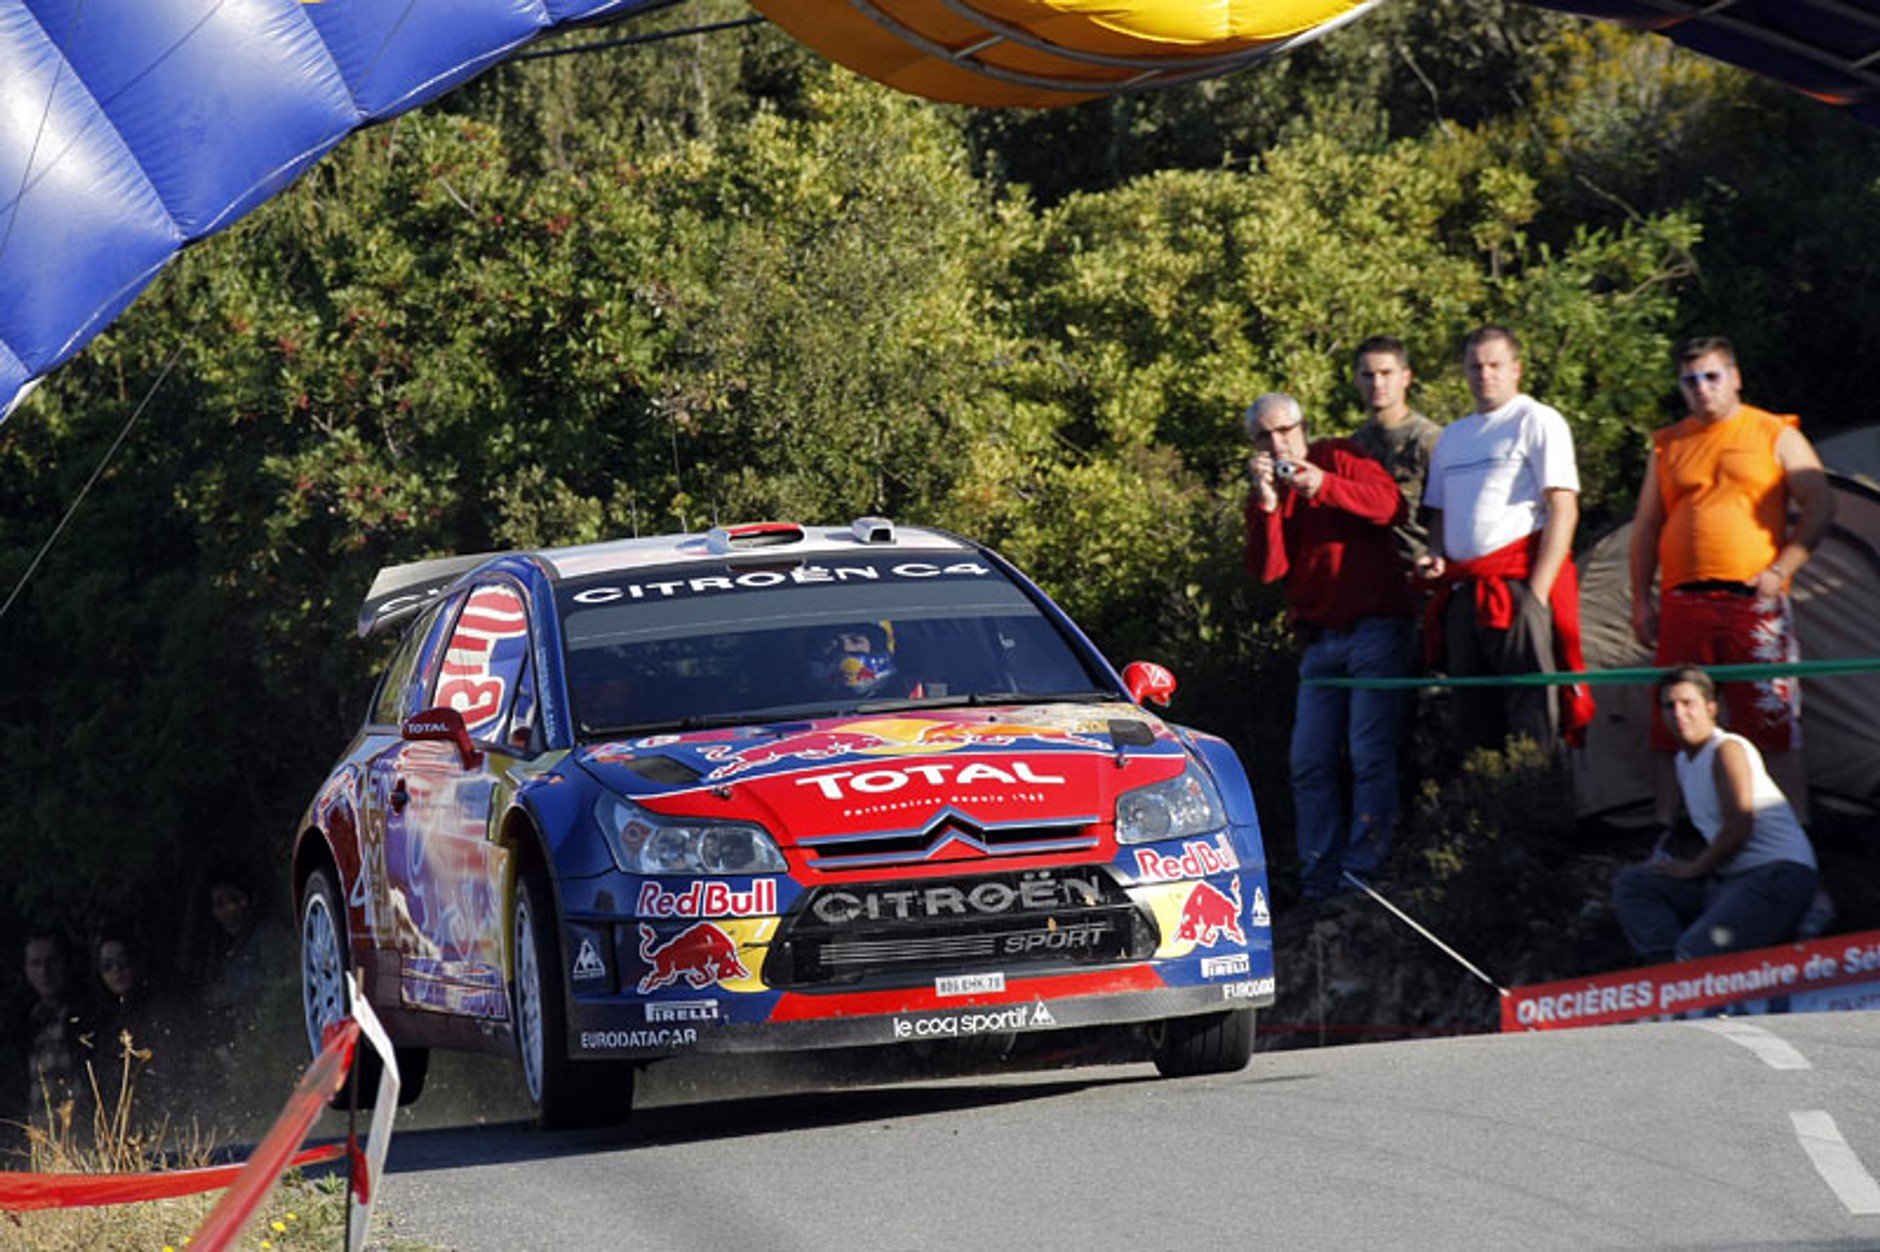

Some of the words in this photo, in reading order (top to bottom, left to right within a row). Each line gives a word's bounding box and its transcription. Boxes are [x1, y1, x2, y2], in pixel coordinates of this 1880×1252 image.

[573, 564, 878, 603] CITROËN
[893, 562, 989, 578] C4
[407, 722, 450, 734] TOTAL
[795, 762, 1066, 800] TOTAL
[1135, 845, 1205, 880] Red
[636, 882, 702, 916] Red
[702, 879, 777, 915] Bull
[813, 872, 1101, 923] CITROËN
[1004, 927, 1102, 953] SPORT
[1516, 979, 1654, 1025] ORCIÈRES
[1660, 962, 1798, 1008] partenaire
[1804, 954, 1838, 979] de
[645, 999, 719, 1022] PIRELLI
[893, 1017, 911, 1037] le
[915, 1011, 958, 1037] coq
[960, 1006, 1030, 1033] sportif
[581, 1028, 698, 1050] EURODATACAR
